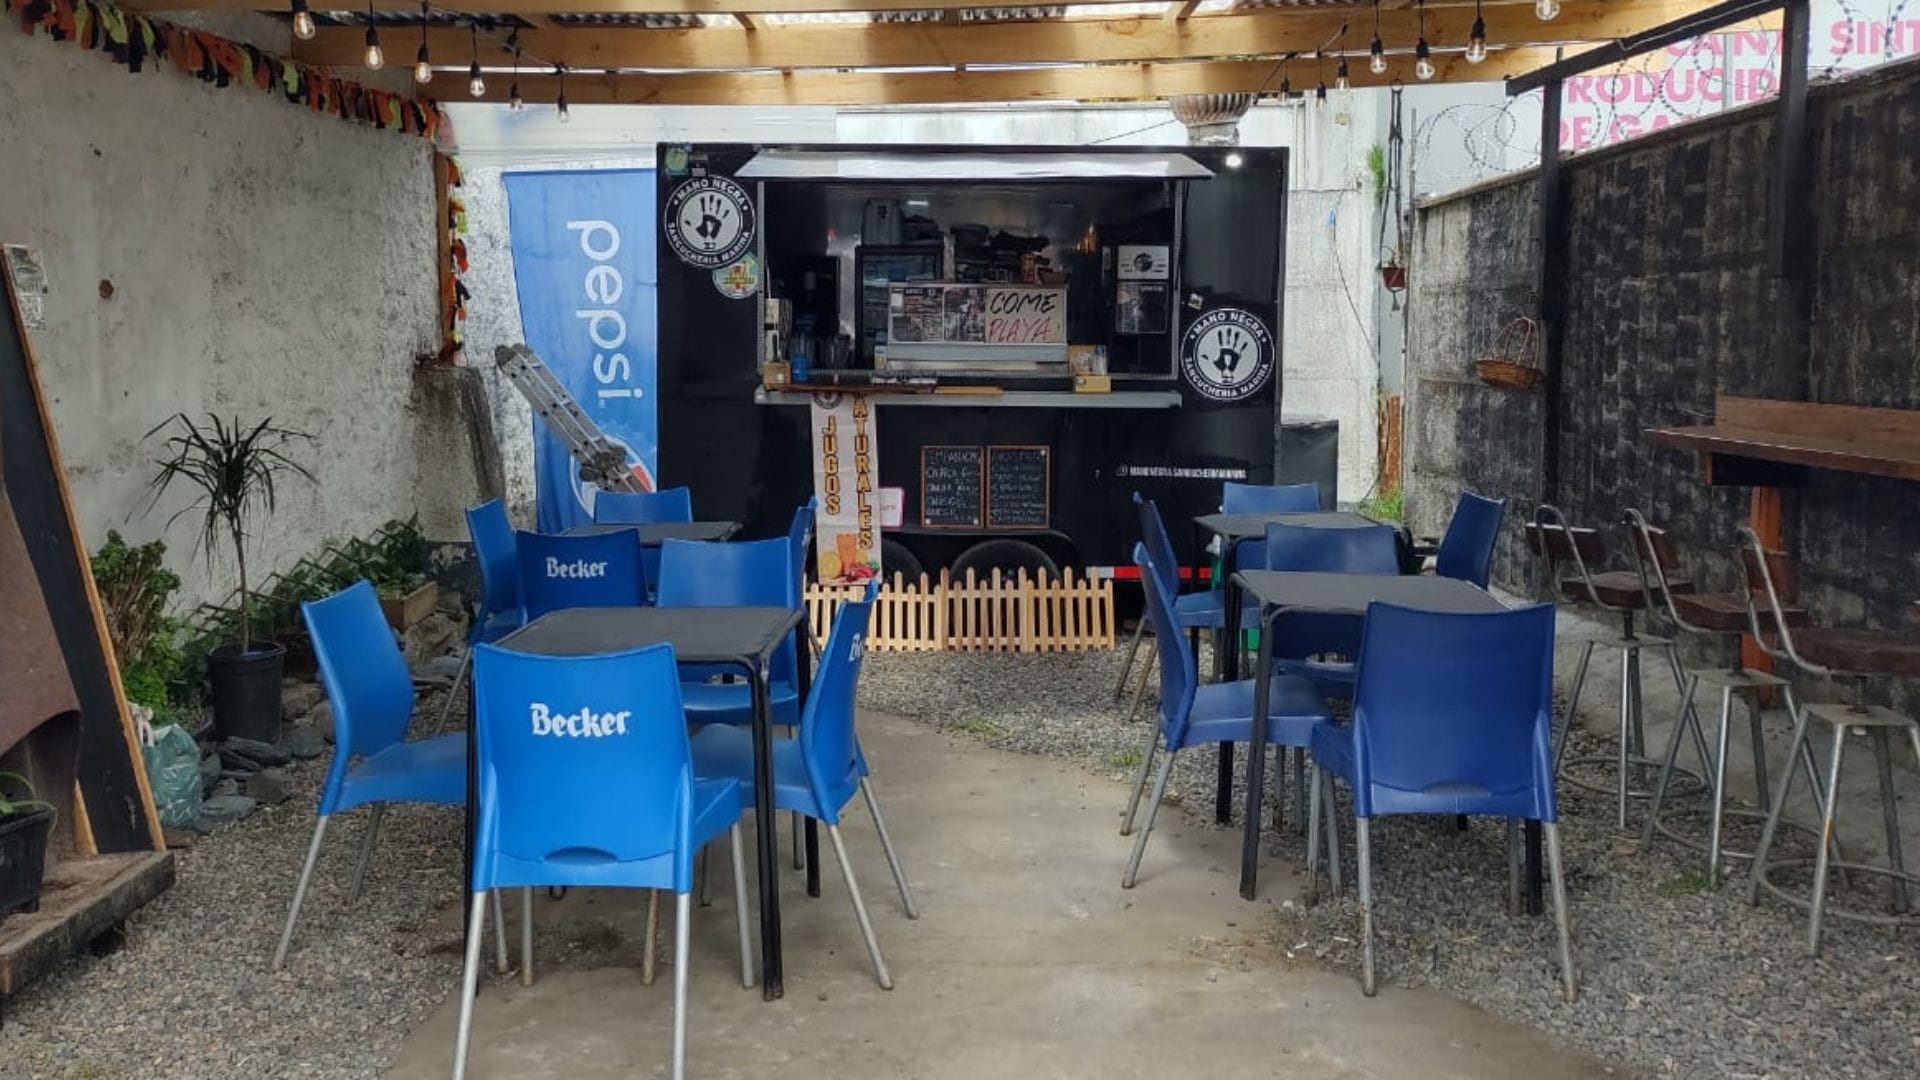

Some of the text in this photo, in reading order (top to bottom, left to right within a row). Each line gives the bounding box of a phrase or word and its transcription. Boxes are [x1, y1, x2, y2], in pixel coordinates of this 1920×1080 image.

[1567, 66, 1778, 103] RODUCID
[677, 179, 746, 204] MANO NEGRA
[567, 220, 643, 398] pepsi
[990, 290, 1058, 314] COME
[1193, 312, 1264, 337] MANO NEGRA
[1240, 364, 1269, 393] MARINA
[822, 415, 840, 515] JUGOS
[546, 557, 608, 578] Becker
[530, 703, 632, 737] Becker
